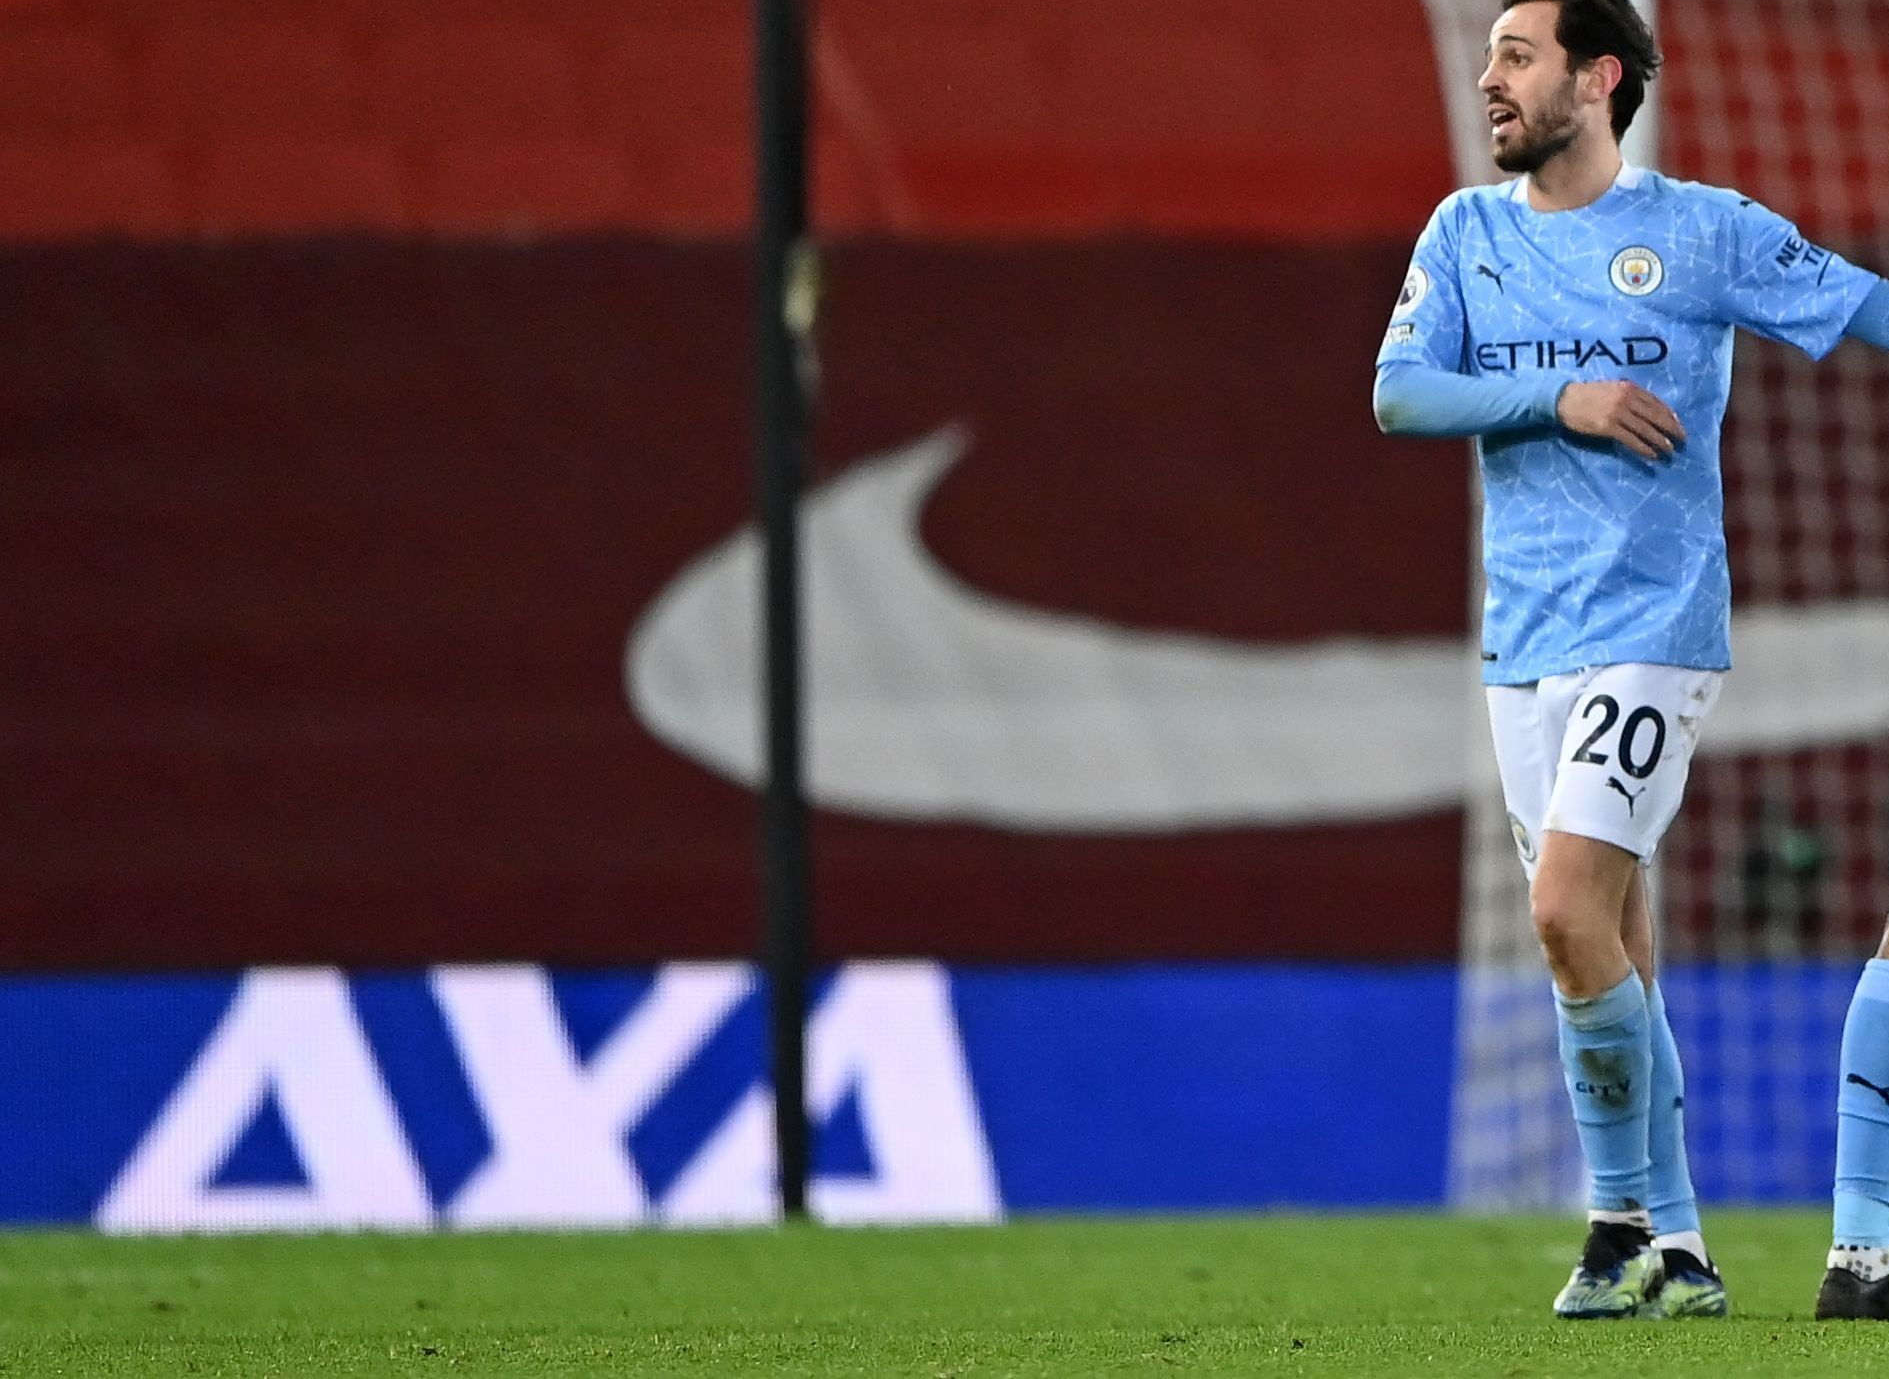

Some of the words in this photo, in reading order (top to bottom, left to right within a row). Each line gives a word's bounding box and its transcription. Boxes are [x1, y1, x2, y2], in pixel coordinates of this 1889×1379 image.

[1476, 335, 1668, 371] ETIHAD
[1571, 694, 1667, 780] 20
[90, 957, 1000, 1233] AXA
